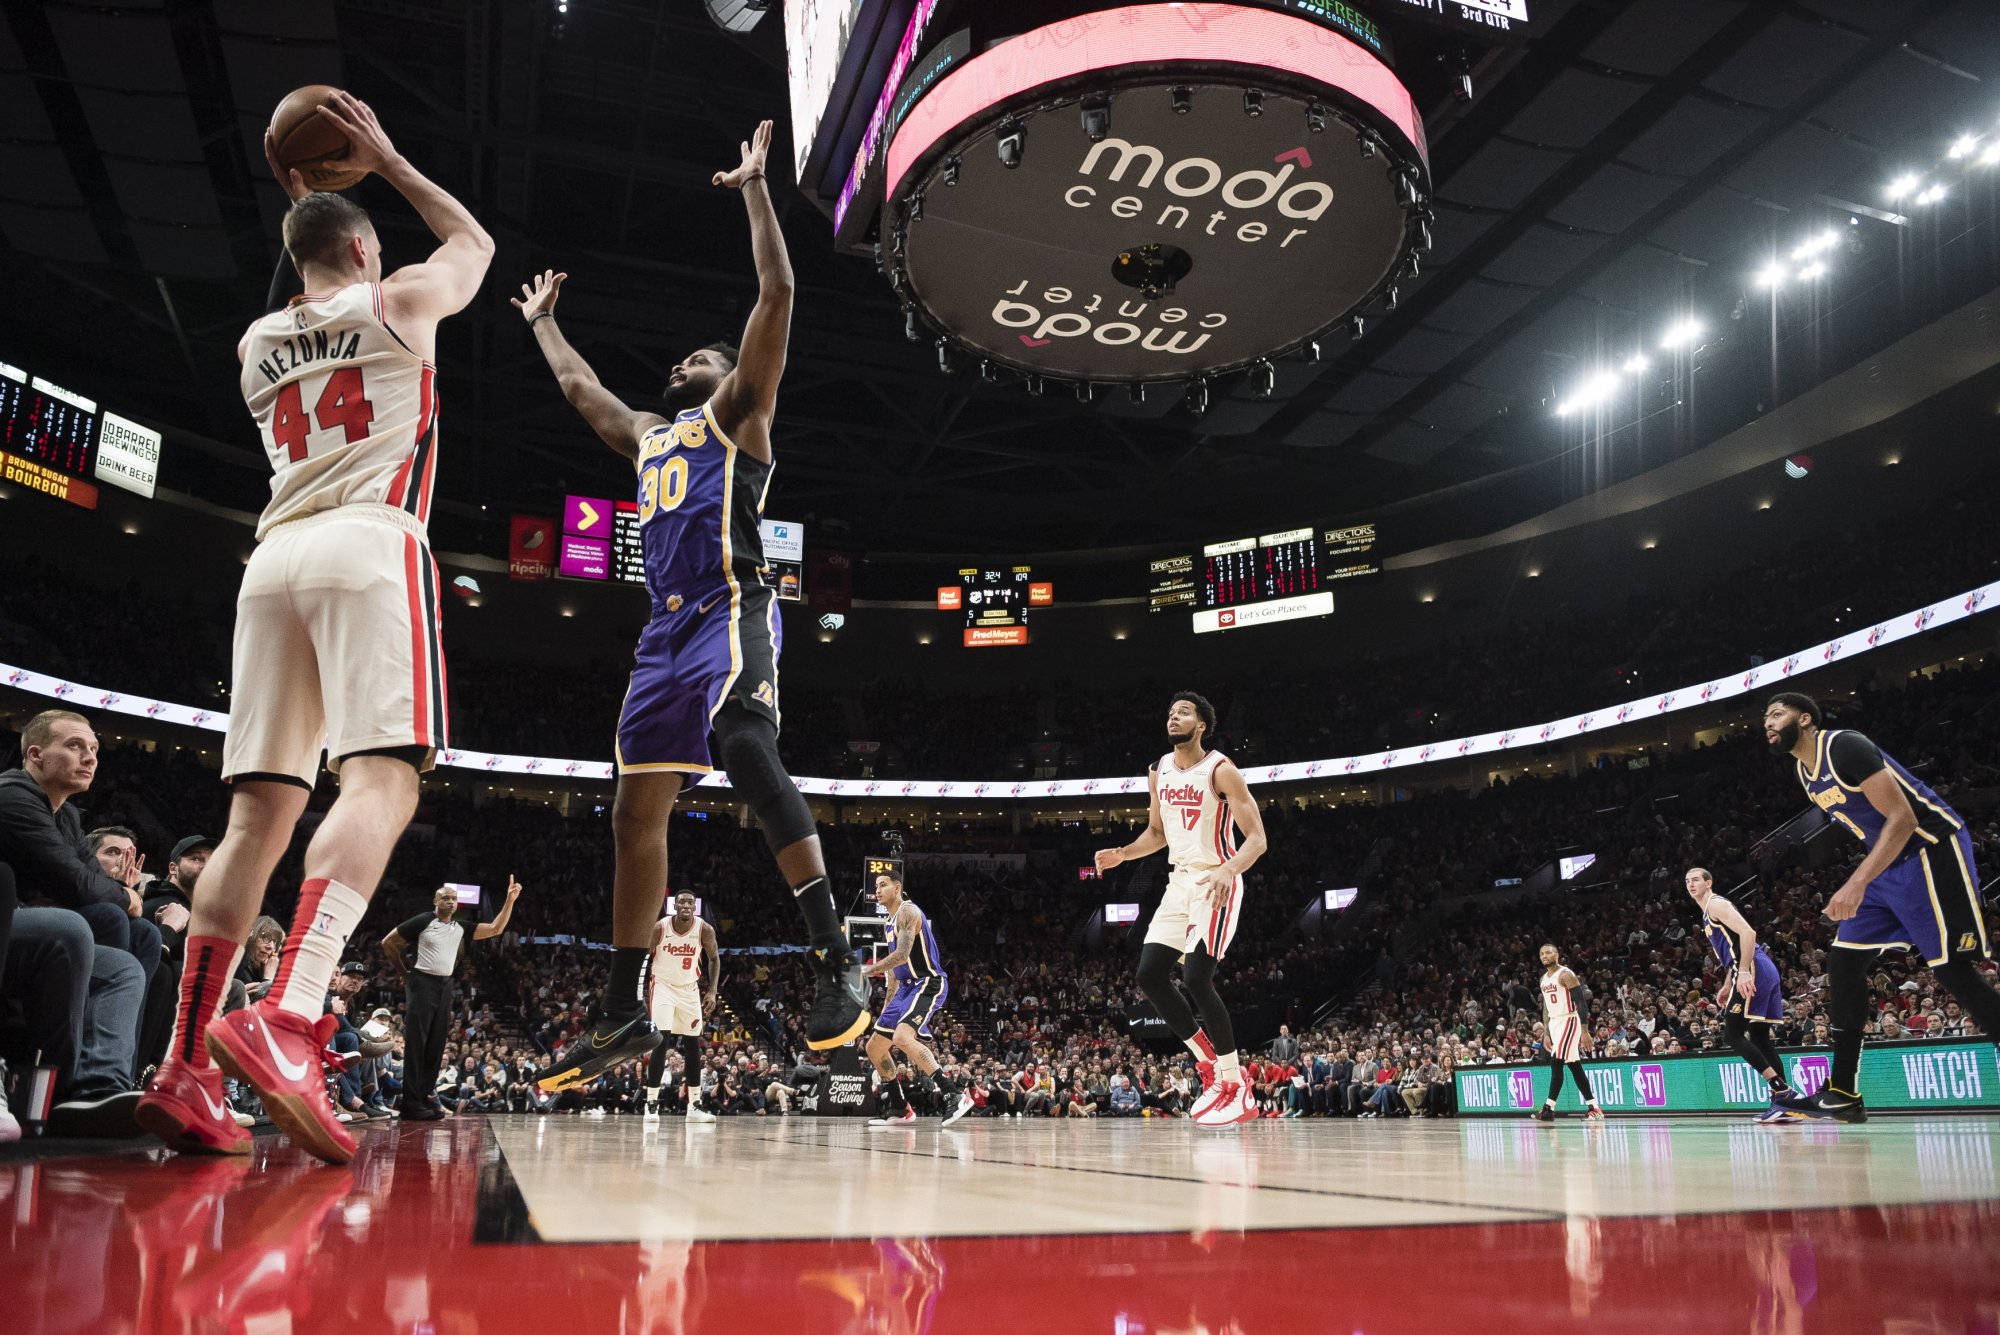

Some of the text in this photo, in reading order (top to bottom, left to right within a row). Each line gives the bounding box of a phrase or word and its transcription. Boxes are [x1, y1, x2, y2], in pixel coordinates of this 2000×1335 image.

[1461, 5, 1482, 22] 3rd
[1486, 12, 1510, 30] QTR
[1326, 11, 1381, 50] COOL THE PAIN
[936, 55, 952, 72] PAIN
[1078, 137, 1334, 221] moda
[1064, 184, 1308, 248] center
[1006, 279, 1227, 328] center
[992, 299, 1212, 354] moda
[258, 330, 361, 384] HEZONJA
[272, 366, 374, 464] 44
[102, 433, 144, 458] BREWING
[8, 455, 39, 473] BROWN
[41, 468, 69, 486] SUGAR
[99, 455, 128, 474] DRINK
[129, 467, 154, 484] BEER
[6, 466, 68, 499] BOURBON
[640, 456, 688, 526] 30
[985, 571, 1001, 580] 32.4
[1016, 573, 1028, 581] 109
[968, 610, 973, 618] 5
[1022, 608, 1027, 616] 3
[1240, 604, 1306, 620] Let's Go Places
[1160, 783, 1204, 806] ripcity
[1181, 808, 1201, 831] 17
[663, 943, 696, 956] ripcity
[682, 957, 692, 970] 9
[1551, 994, 1557, 1004] 0
[1144, 1018, 1154, 1026] Just
[829, 1081, 861, 1094] Season
[1645, 1073, 1660, 1098] TV
[1718, 1063, 1772, 1102] WATC
[1808, 1066, 1827, 1097] TV
[1902, 1051, 1981, 1100] WATCH
[830, 1092, 865, 1106] of Giving
[1462, 1075, 1500, 1107] WATCH
[1518, 1078, 1529, 1101] TV
